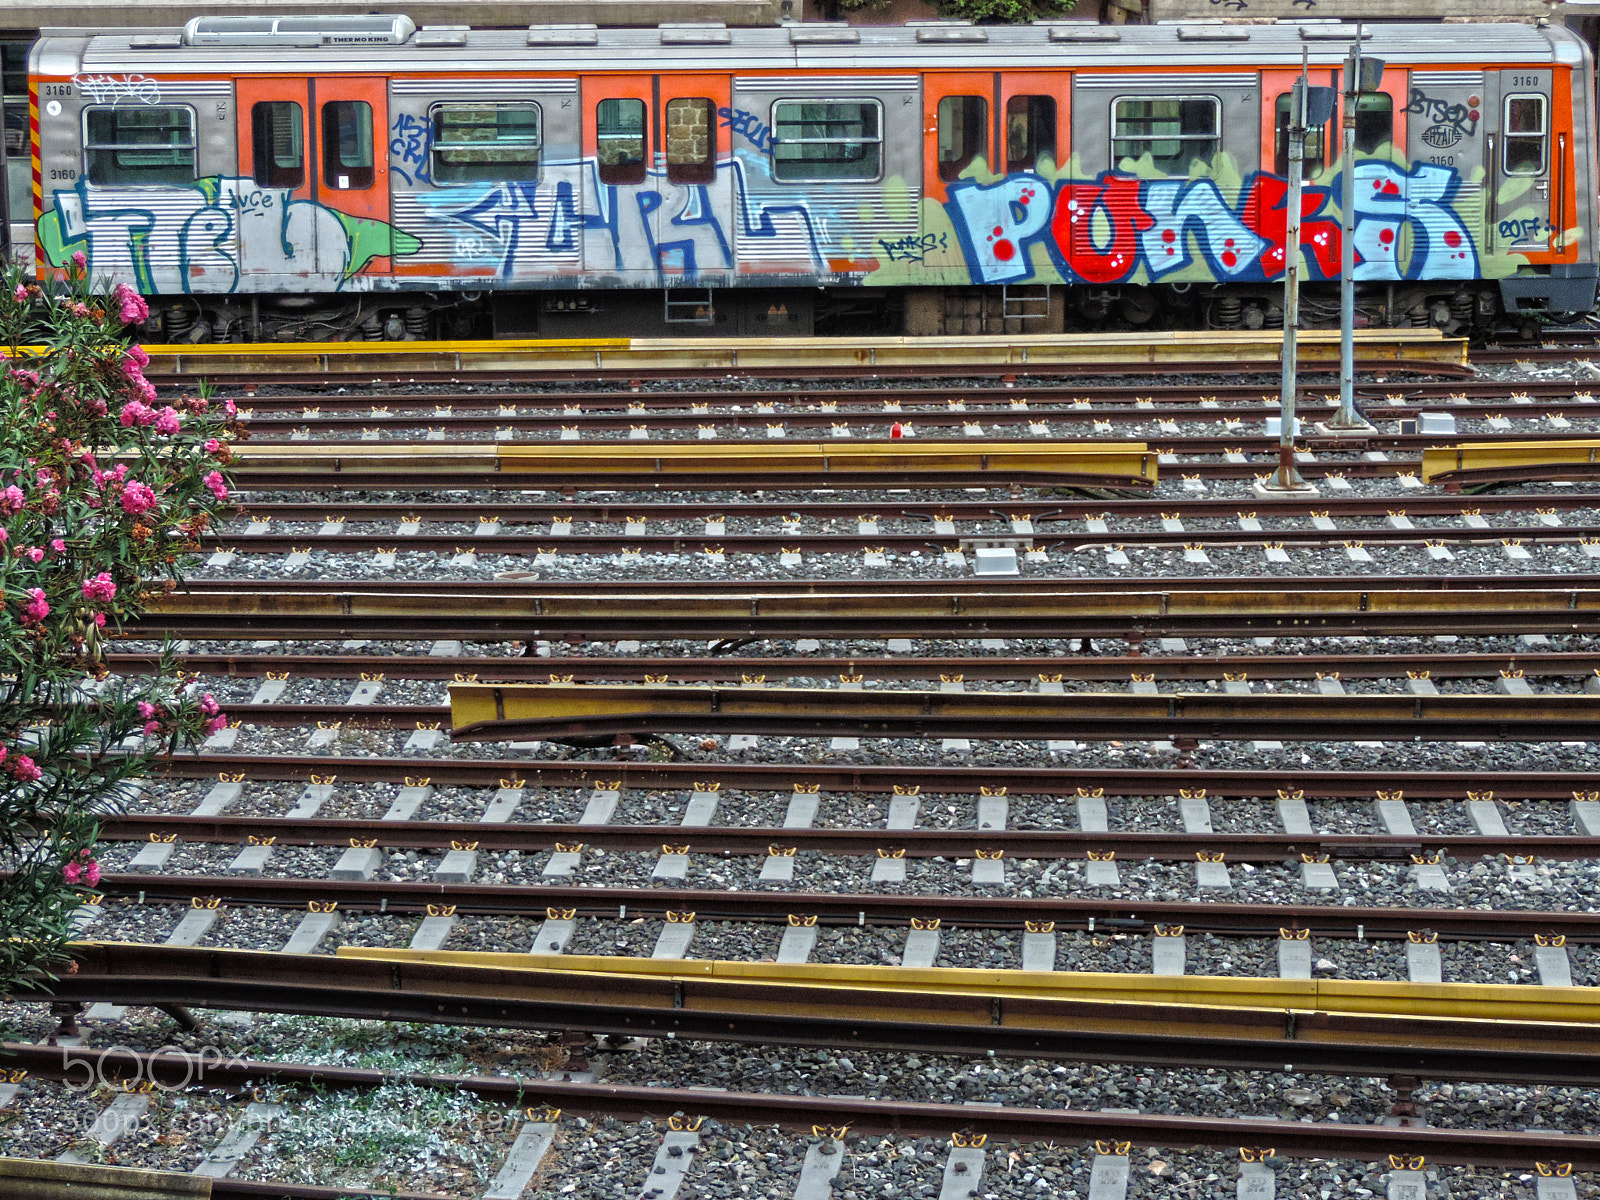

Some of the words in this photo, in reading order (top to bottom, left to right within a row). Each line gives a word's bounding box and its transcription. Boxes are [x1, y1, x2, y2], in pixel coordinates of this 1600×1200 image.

[1512, 76, 1539, 87] 3160
[45, 85, 72, 96] 3160
[1429, 156, 1454, 167] 3160
[50, 169, 76, 180] 3160
